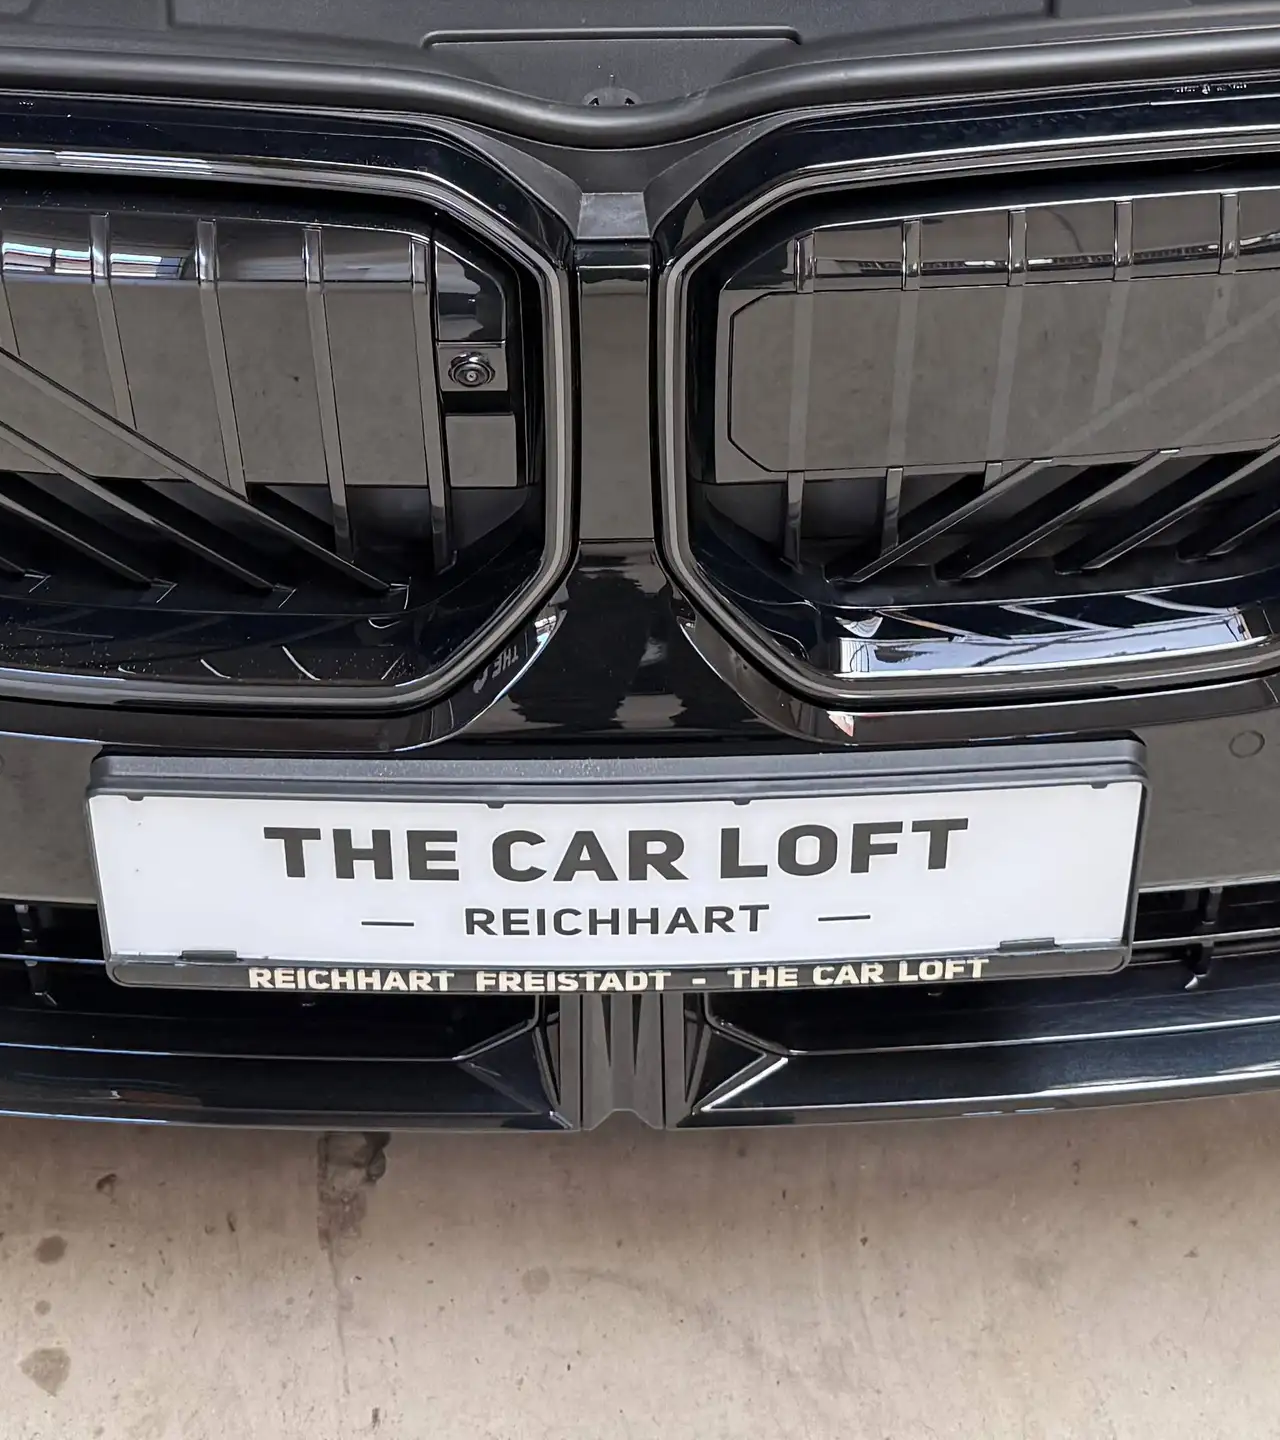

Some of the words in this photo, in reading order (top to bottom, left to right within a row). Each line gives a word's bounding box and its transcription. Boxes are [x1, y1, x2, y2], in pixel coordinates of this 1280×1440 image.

[263, 826, 460, 881] THE
[492, 829, 689, 882] CAR
[720, 817, 969, 879] LOFT
[465, 904, 770, 936] REICHHART
[248, 967, 455, 992] REICHHART
[475, 969, 672, 992] FREISTADT
[726, 966, 799, 989] THE
[812, 962, 885, 986] CAR
[898, 956, 990, 982] LOFT
